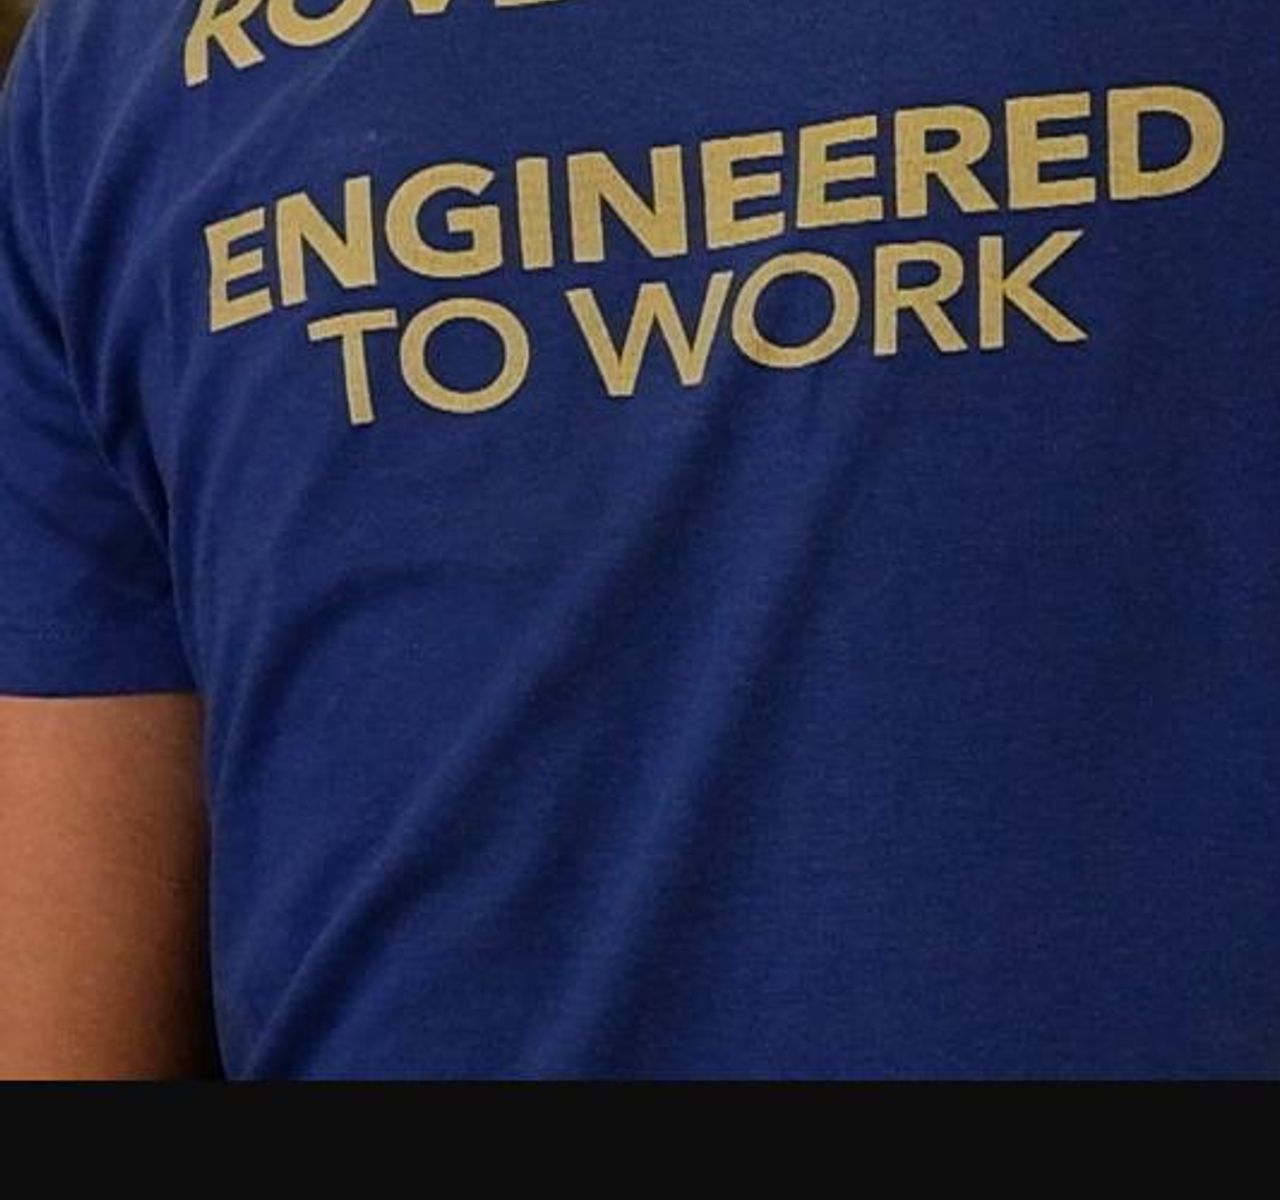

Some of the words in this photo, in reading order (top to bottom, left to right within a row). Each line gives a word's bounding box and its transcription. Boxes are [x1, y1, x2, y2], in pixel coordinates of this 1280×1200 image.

[204, 85, 1226, 331] ENGINEERED
[308, 297, 531, 424] TO
[566, 230, 1087, 397] WORK
